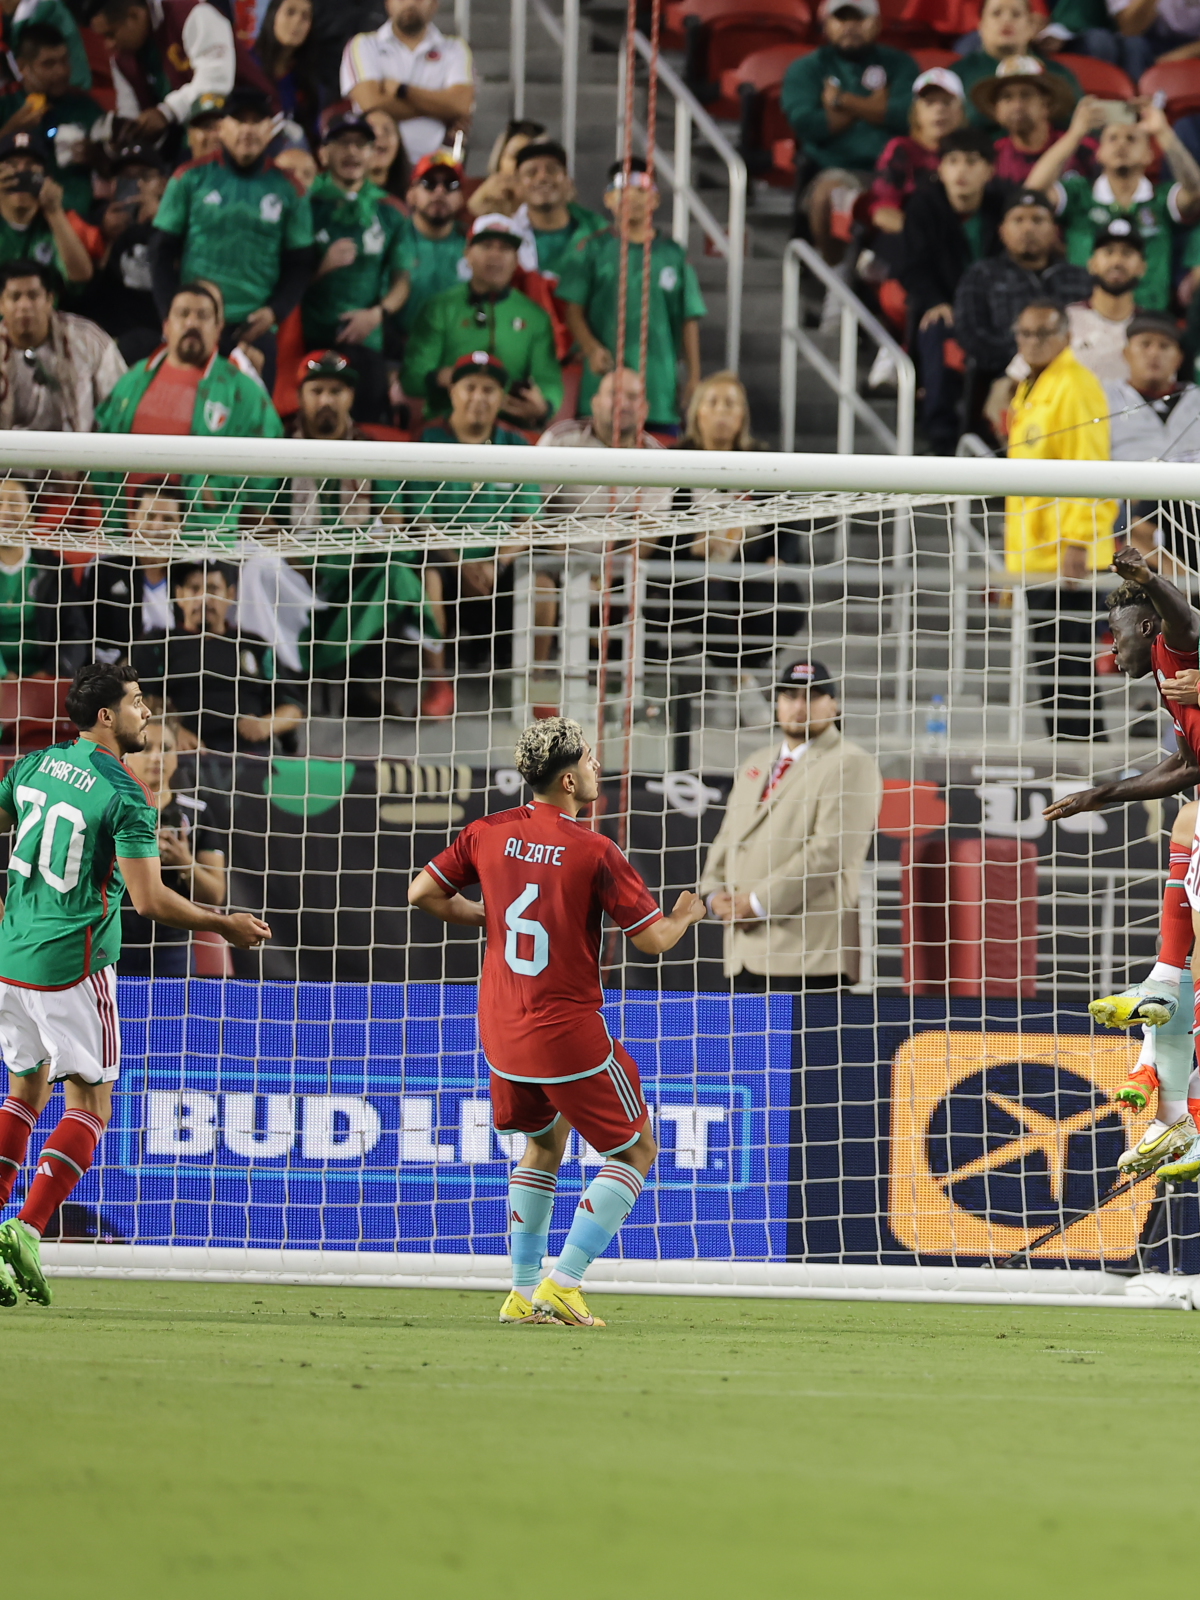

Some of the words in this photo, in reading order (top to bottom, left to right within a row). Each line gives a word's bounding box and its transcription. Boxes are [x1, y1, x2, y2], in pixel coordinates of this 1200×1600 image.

[8, 785, 88, 894] 20
[504, 837, 566, 866] ALZATE
[504, 882, 550, 977] 6
[146, 1088, 382, 1160] BUD
